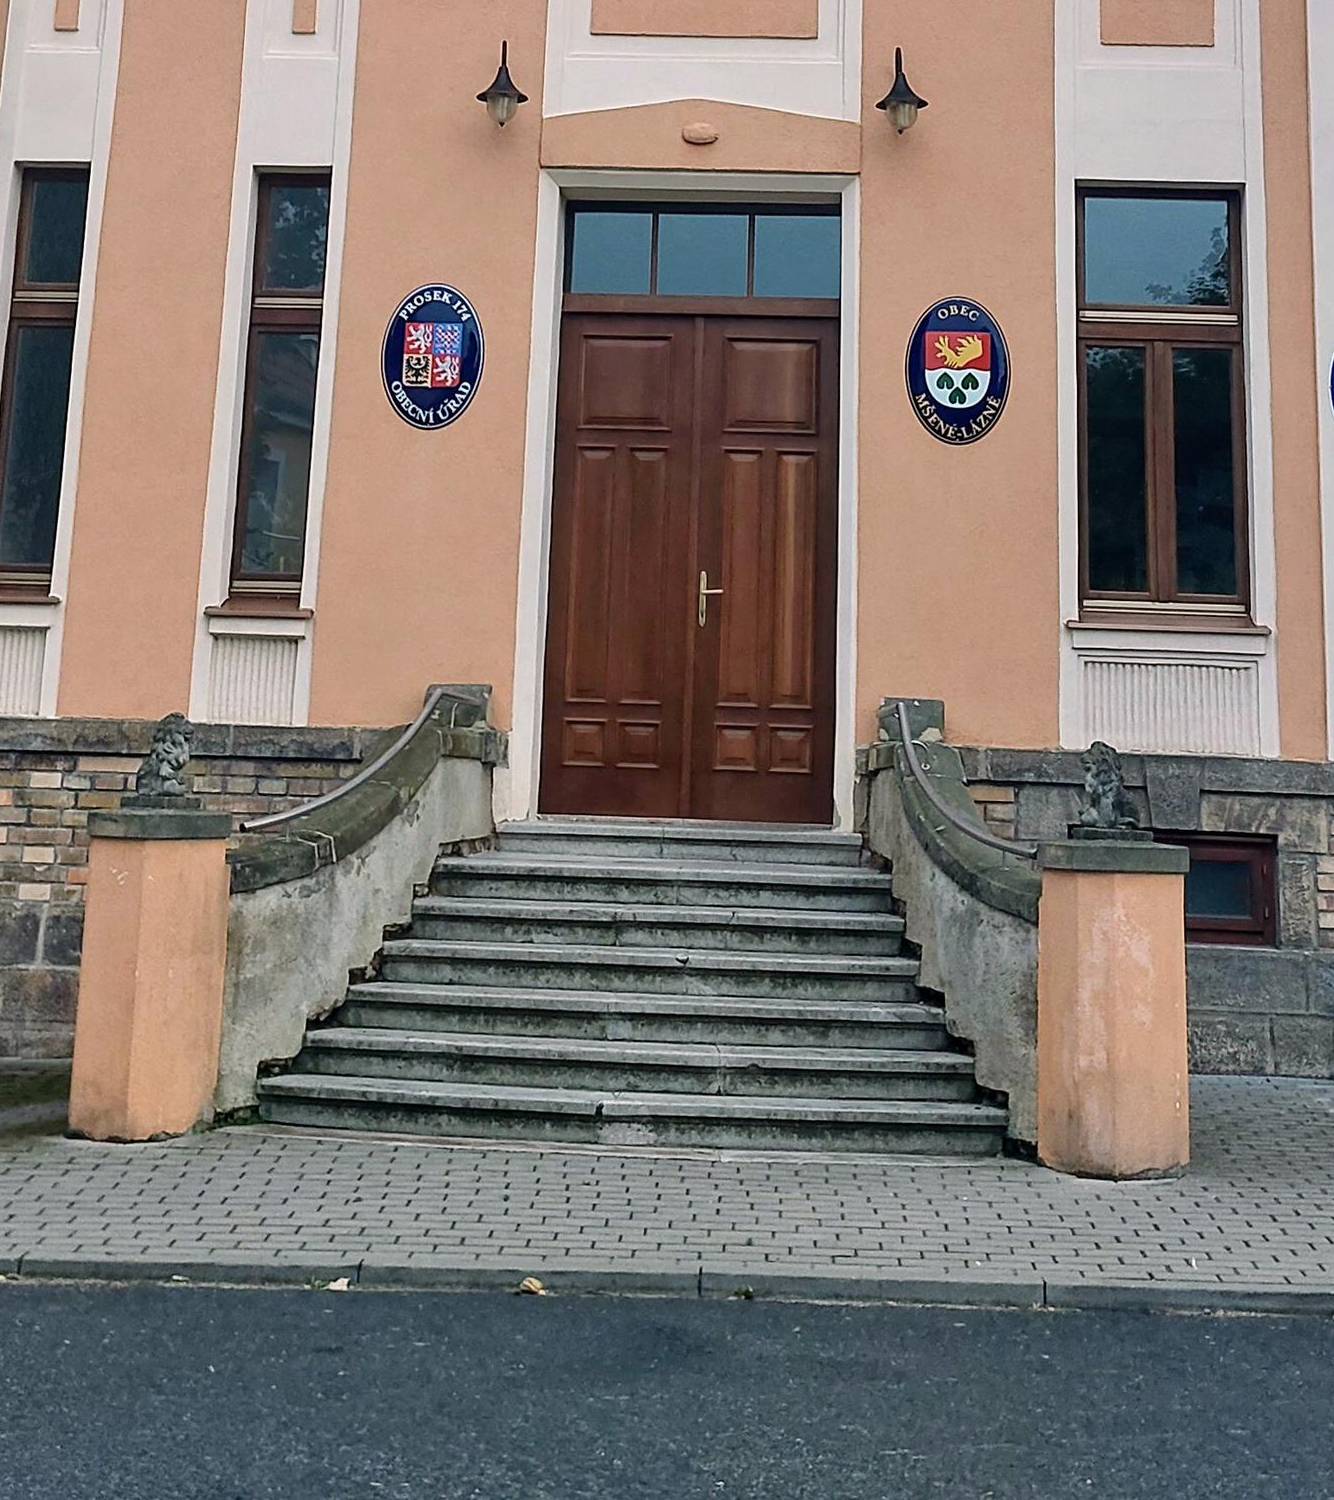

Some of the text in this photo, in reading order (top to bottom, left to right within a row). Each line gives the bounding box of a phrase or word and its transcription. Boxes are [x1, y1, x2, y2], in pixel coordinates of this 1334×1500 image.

[398, 290, 472, 322] PROSEK 174
[937, 304, 980, 322] OBEC
[391, 380, 472, 423] OBECNÍ ÚŘAD
[916, 393, 1002, 440] MŠENÉ-LÁZNĚ
